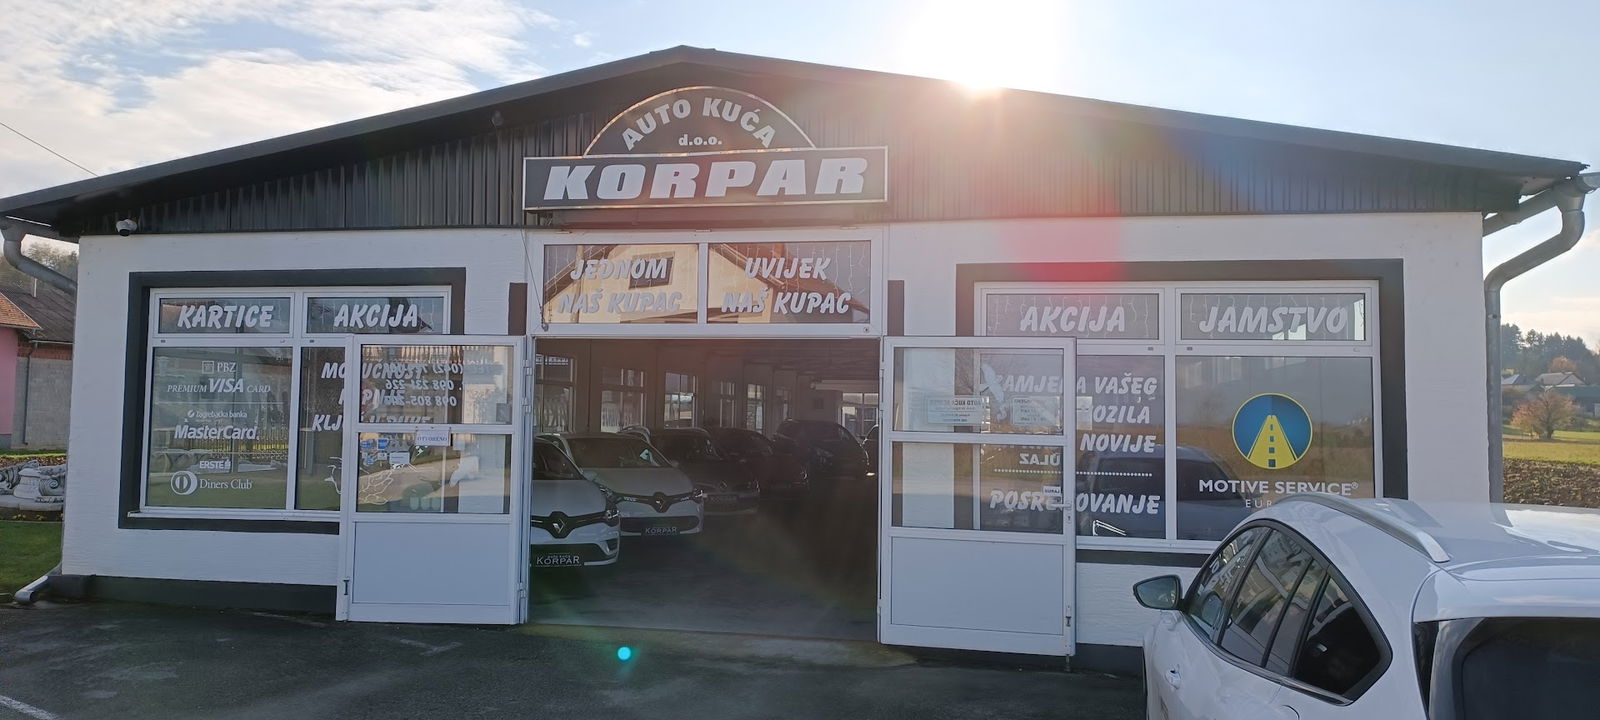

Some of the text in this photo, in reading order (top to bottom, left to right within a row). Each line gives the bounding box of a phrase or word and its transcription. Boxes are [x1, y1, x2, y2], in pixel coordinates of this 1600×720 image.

[620, 97, 776, 150] AUTO KUĆA
[678, 134, 722, 146] d.o.o.
[543, 158, 867, 200] KORPAR
[570, 258, 669, 280] JEDNOM
[744, 257, 831, 279] UVIJEK
[557, 288, 682, 313] NAŠ KUPAC
[721, 287, 851, 313] NAŠ KUPAC
[177, 304, 274, 329] KARTICE
[333, 304, 418, 328] AKCIJA
[1020, 306, 1125, 333] AKCIJA
[1199, 306, 1348, 333] JAMSTVO
[217, 362, 237, 373] PBZ
[167, 378, 271, 393] PREMIUM VISA CARD
[1095, 372, 1158, 396] VAŠEG
[229, 410, 248, 418] banka
[1091, 405, 1150, 424] OZILA
[174, 425, 259, 440] MasterCard
[1080, 434, 1157, 453] NOVIJE
[200, 460, 225, 469] ERSTE
[200, 478, 252, 489] Diners Club
[1199, 479, 1269, 494] MOTIVE
[990, 489, 1161, 514] POSREOVANJE
[1245, 499, 1273, 508] EUR
[536, 555, 580, 565] KORPAR
